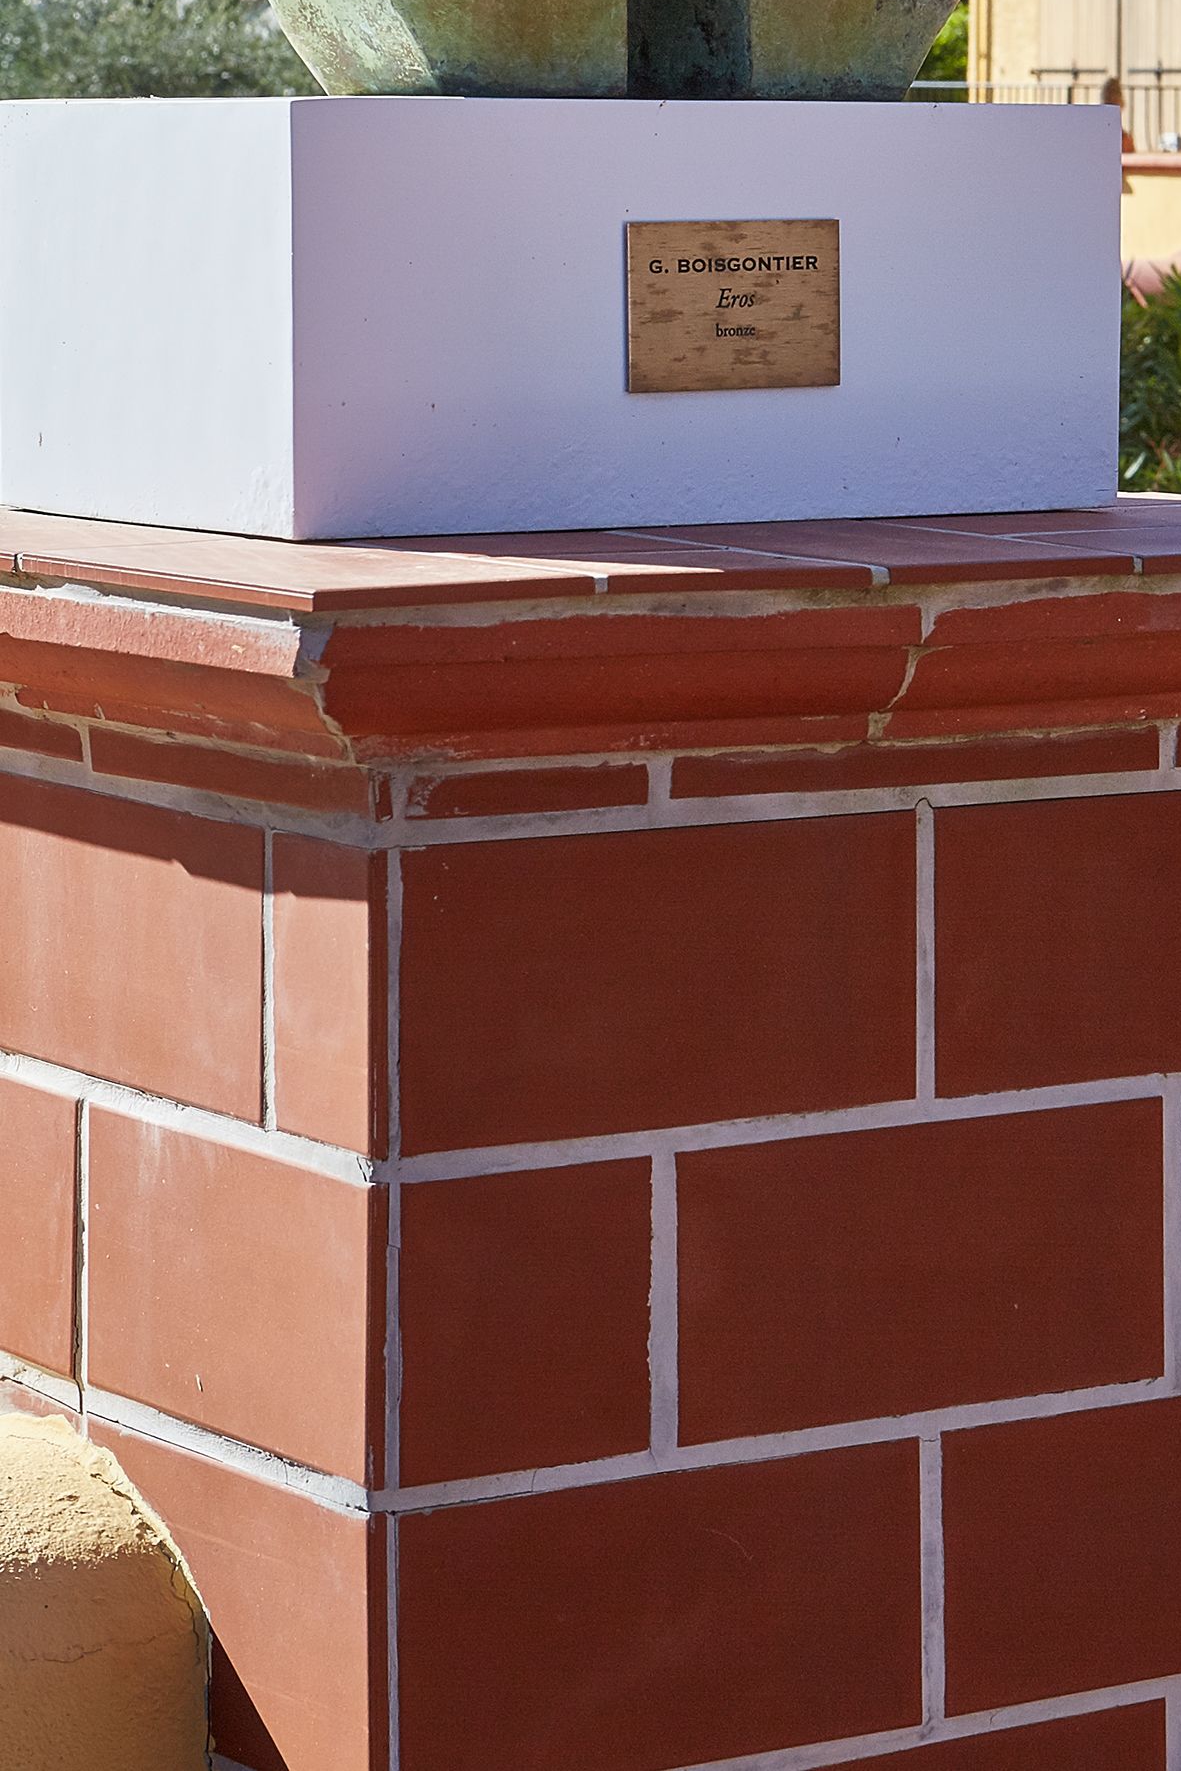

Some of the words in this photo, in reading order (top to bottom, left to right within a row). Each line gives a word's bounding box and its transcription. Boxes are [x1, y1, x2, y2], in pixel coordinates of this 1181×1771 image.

[649, 259, 669, 274] G.
[677, 256, 818, 273] BOISGONTIER
[715, 288, 756, 308] Eros
[715, 323, 756, 338] bronze
